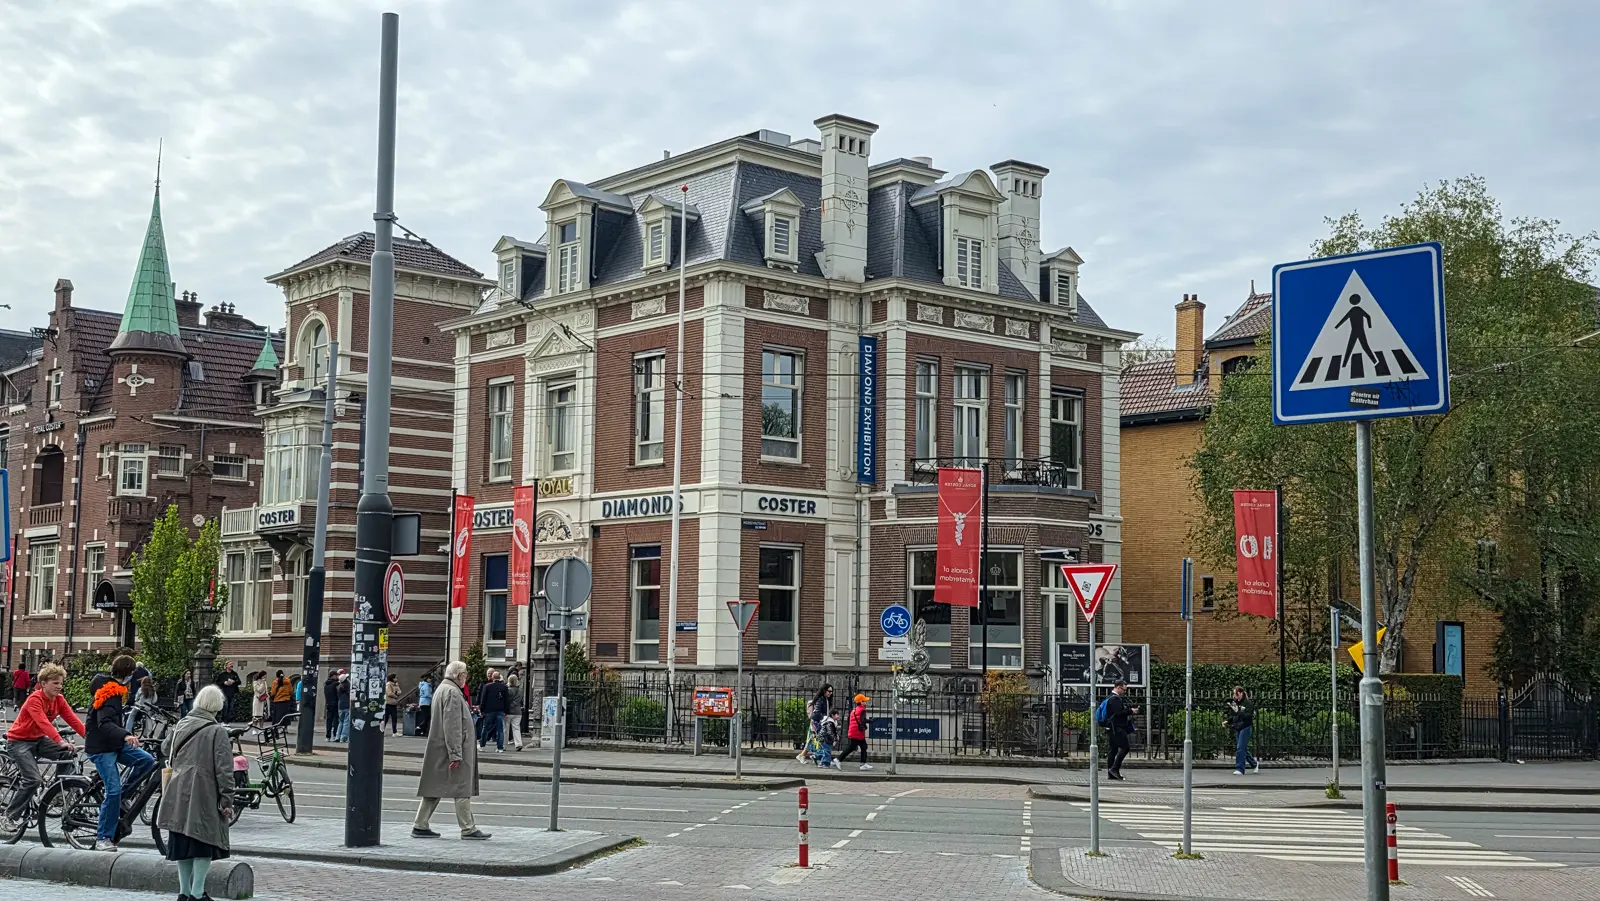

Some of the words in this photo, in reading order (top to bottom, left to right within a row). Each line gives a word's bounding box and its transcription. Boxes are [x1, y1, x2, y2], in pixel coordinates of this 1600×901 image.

[864, 344, 872, 405] DIAMOND
[863, 407, 872, 476] EXHIBITION
[538, 478, 568, 495] ROYAL
[758, 496, 817, 514] COSTER
[259, 509, 295, 525] COSTER
[472, 508, 514, 528] OSTER
